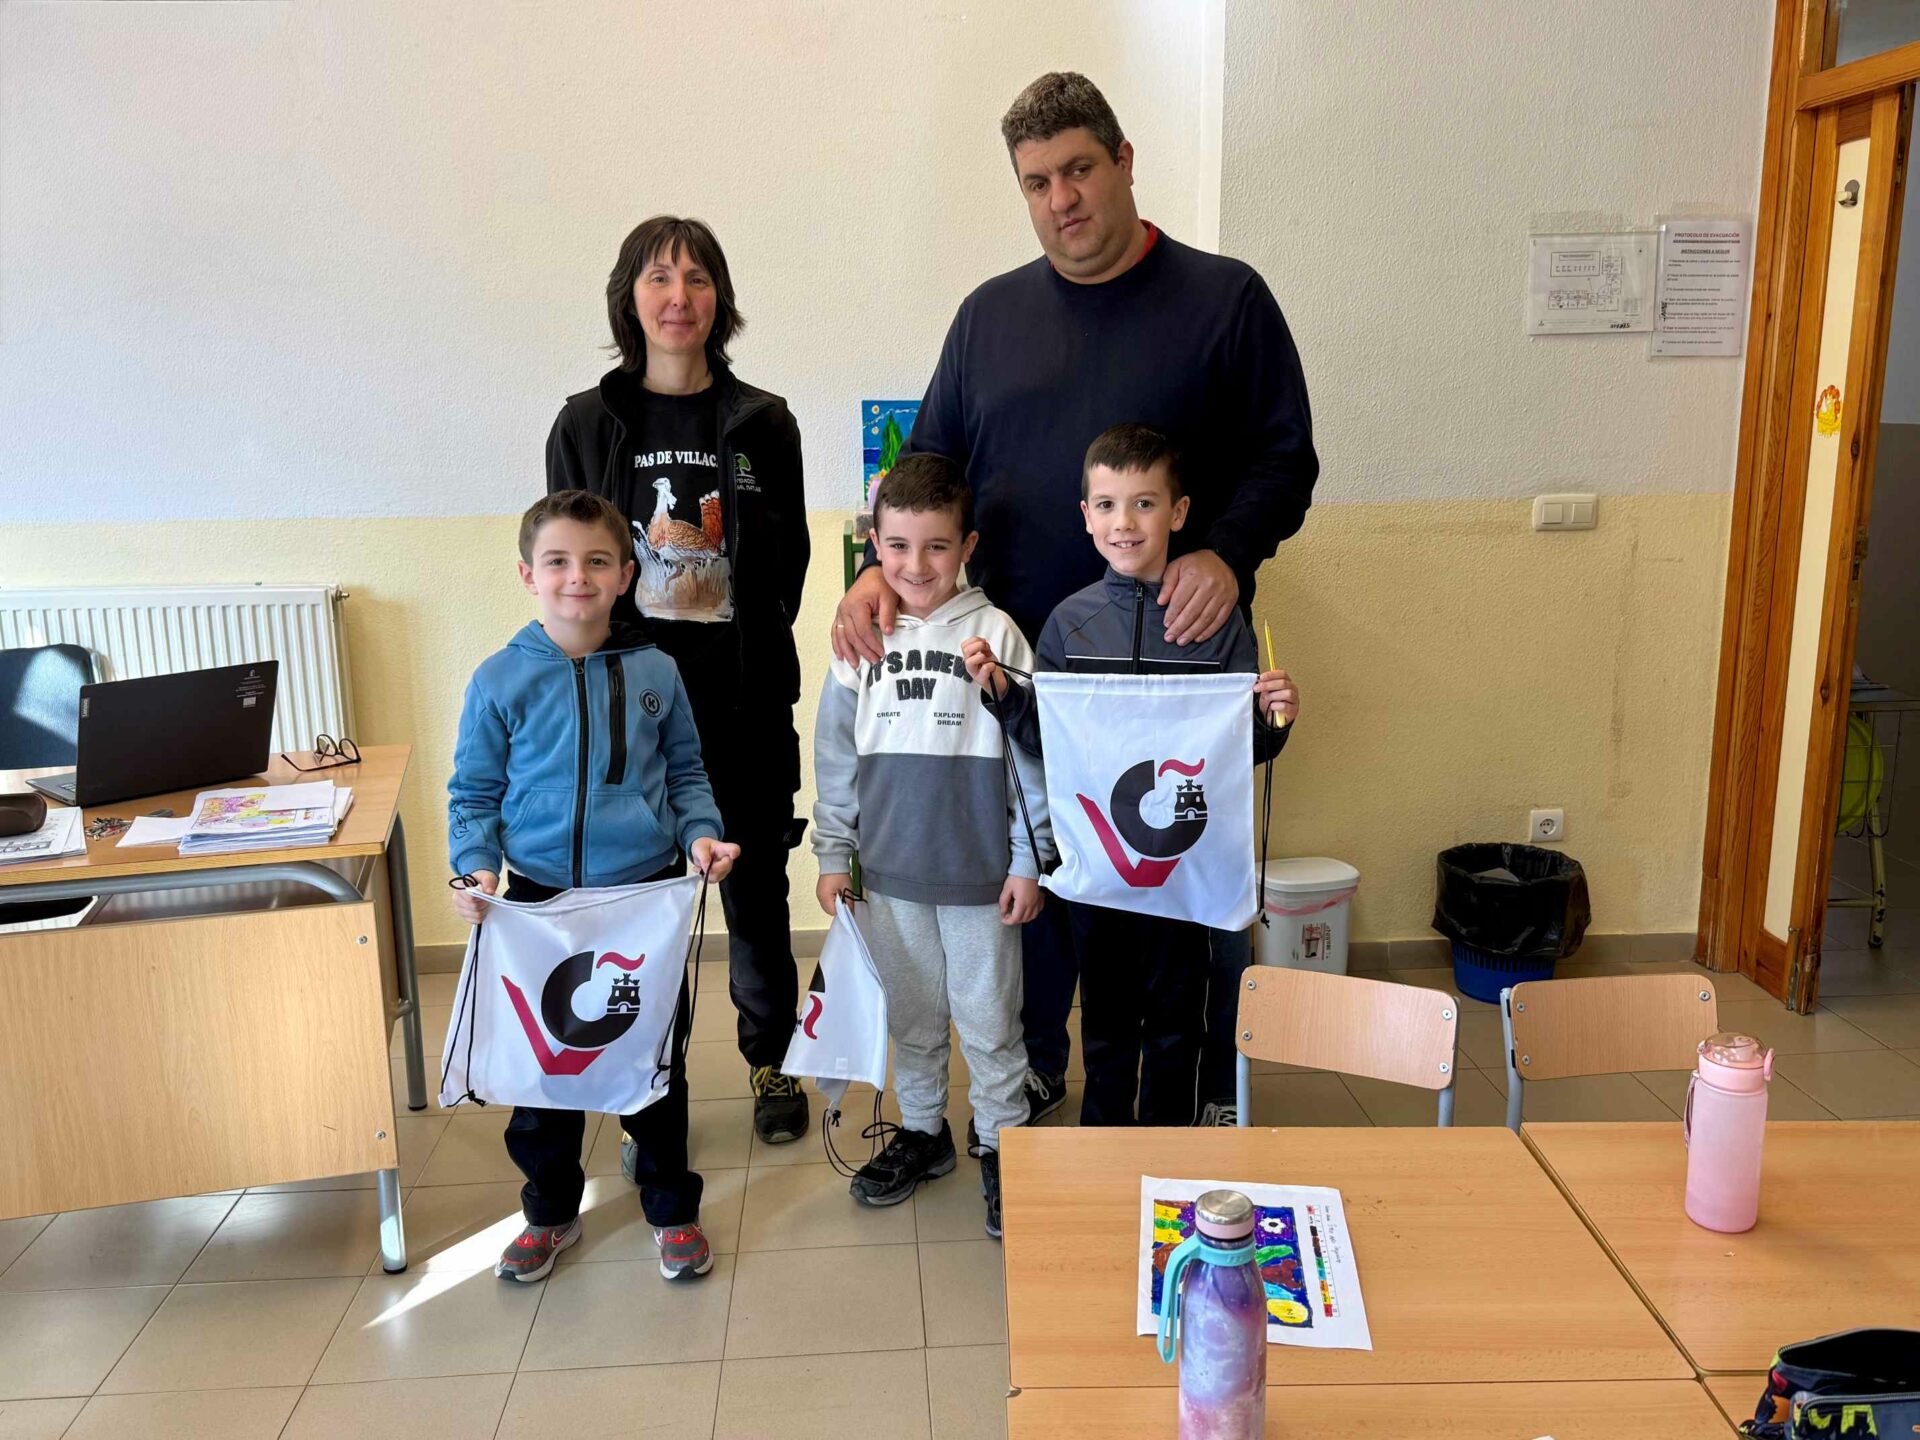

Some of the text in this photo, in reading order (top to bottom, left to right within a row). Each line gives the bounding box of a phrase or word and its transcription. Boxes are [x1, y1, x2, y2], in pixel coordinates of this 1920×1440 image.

[634, 453, 654, 468] PAS
[656, 451, 673, 465] DE
[905, 649, 922, 671] A
[896, 677, 937, 701] DAY
[933, 711, 966, 719] EXPLORE
